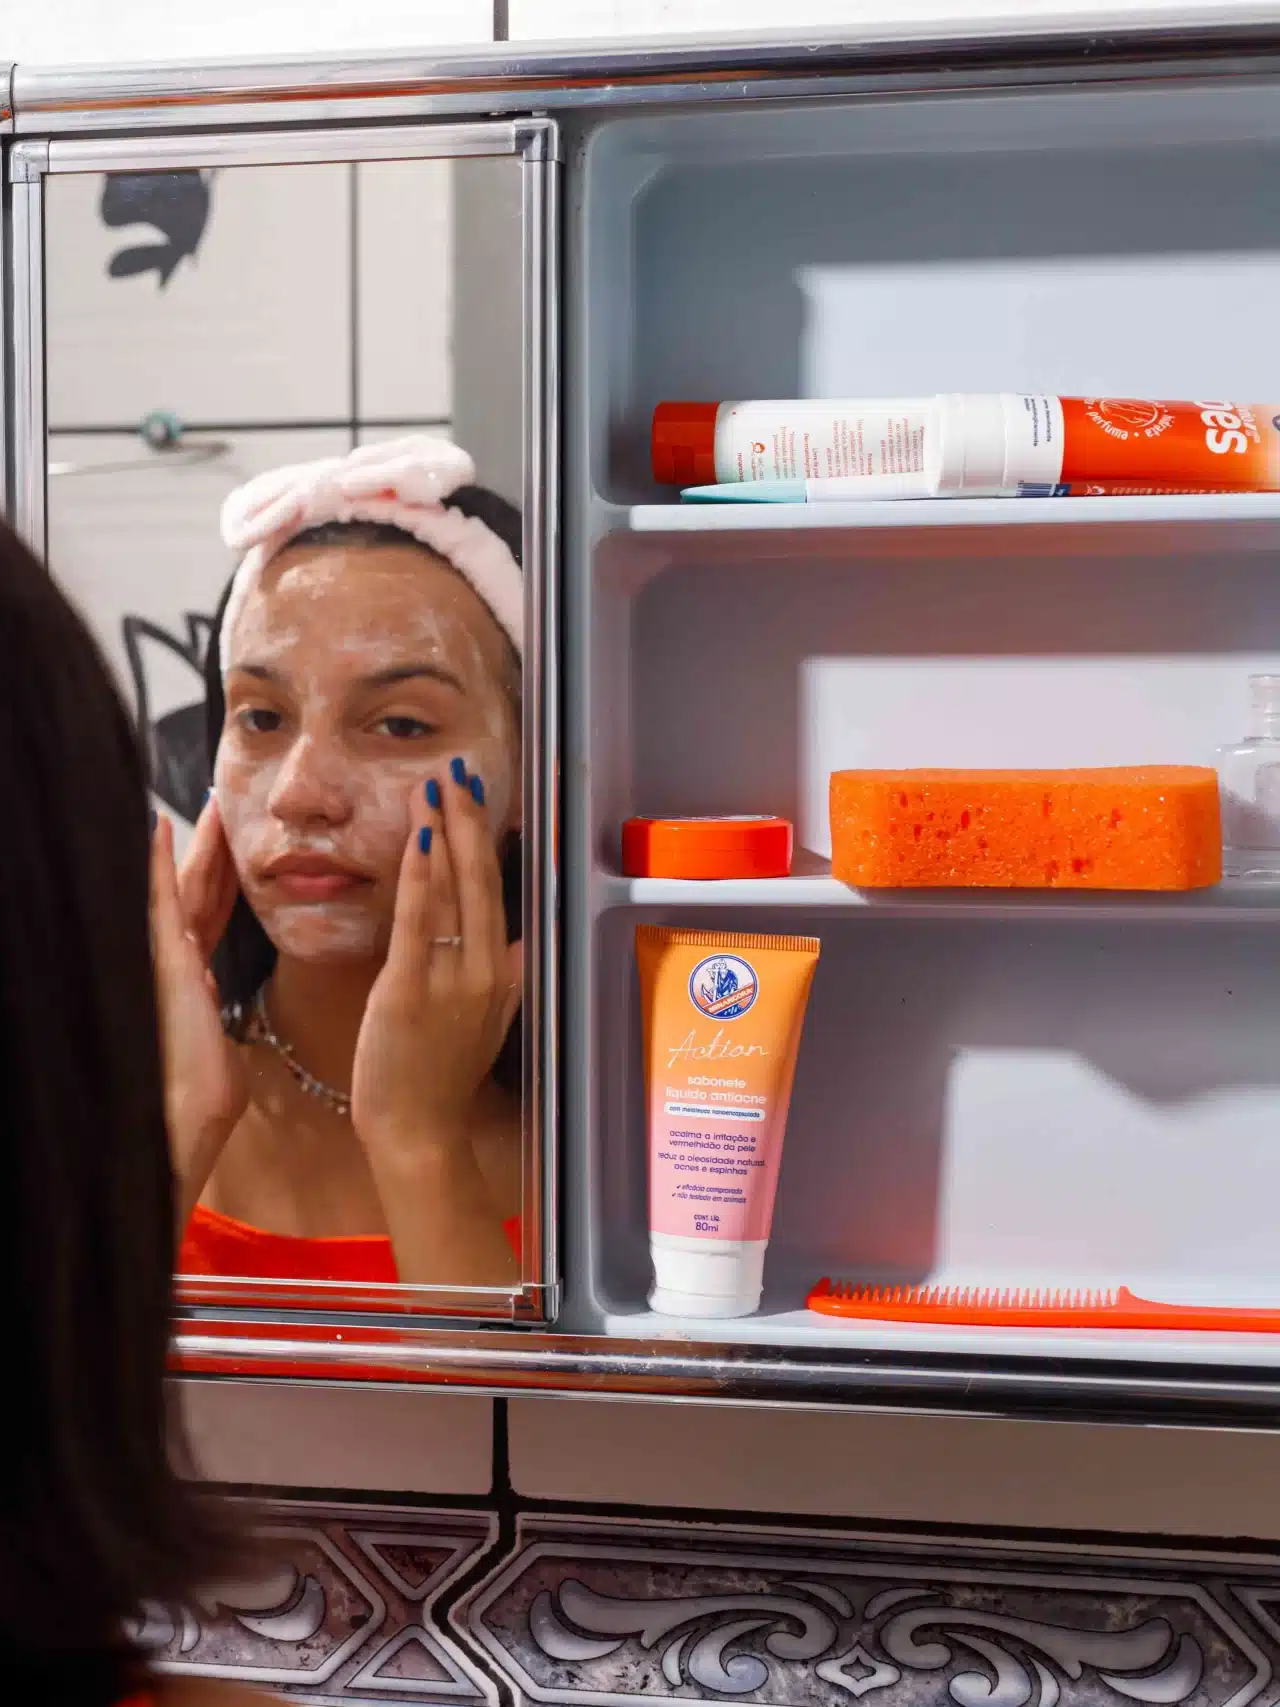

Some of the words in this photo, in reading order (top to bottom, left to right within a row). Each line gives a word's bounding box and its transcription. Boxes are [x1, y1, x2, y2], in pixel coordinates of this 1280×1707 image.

[1084, 411, 1129, 440] perfuma
[667, 1027, 769, 1069] Action
[687, 1075, 747, 1089] sabonete
[710, 1091, 767, 1104] antiacne
[669, 1129, 702, 1139] acalma
[713, 1132, 749, 1144] irritação
[669, 1139, 721, 1150] vermelhidão
[723, 1143, 736, 1151] da
[657, 1152, 677, 1161] reduz
[687, 1154, 735, 1165] oleosidade
[674, 1163, 700, 1172] acnes
[709, 1166, 748, 1176] espinhas
